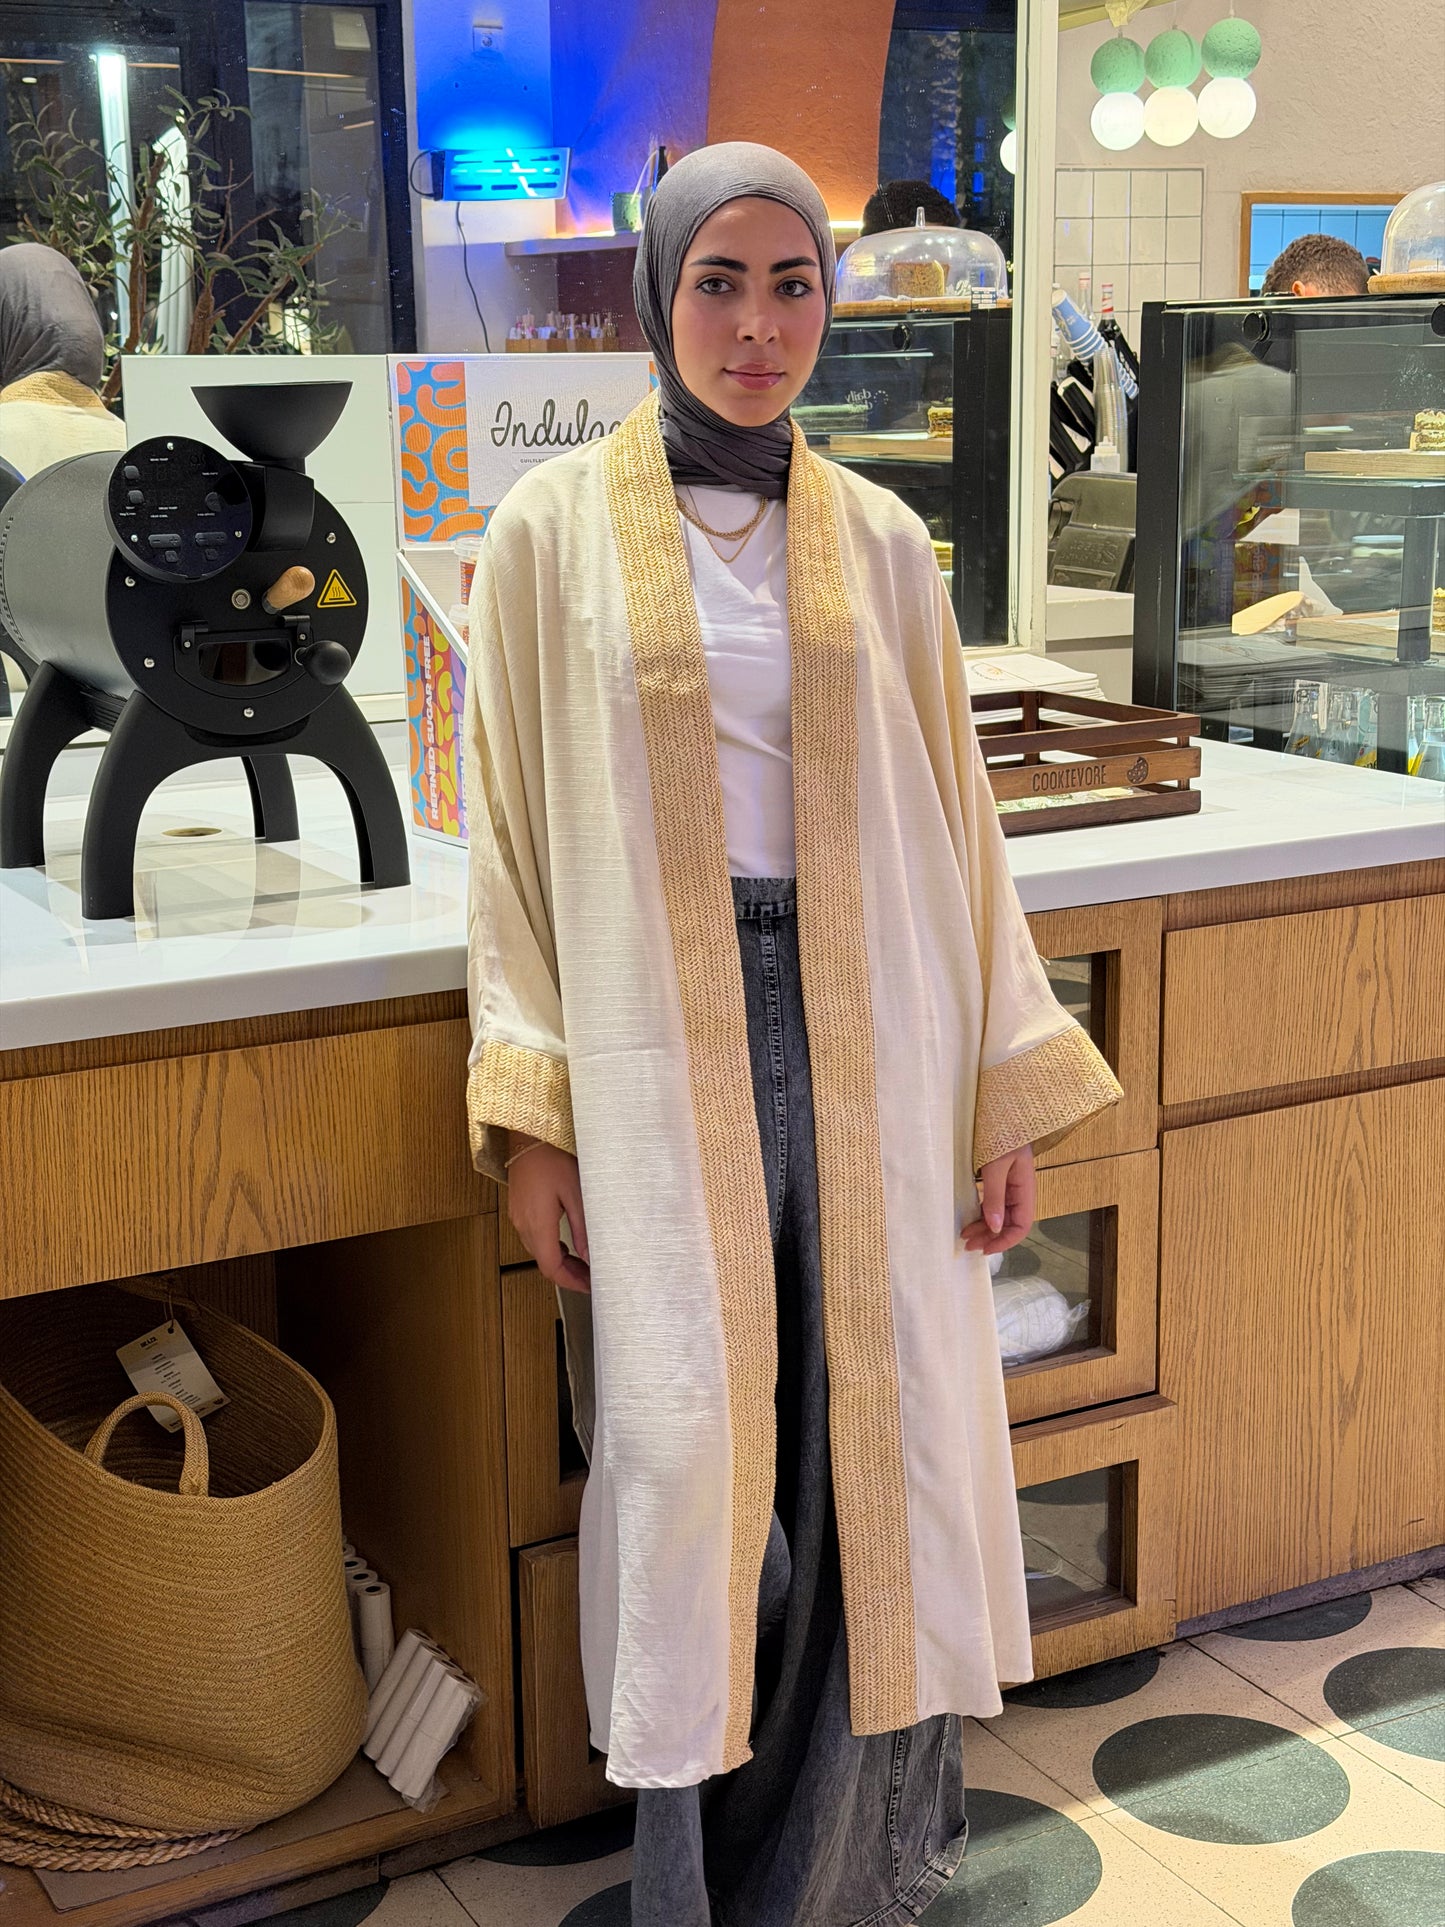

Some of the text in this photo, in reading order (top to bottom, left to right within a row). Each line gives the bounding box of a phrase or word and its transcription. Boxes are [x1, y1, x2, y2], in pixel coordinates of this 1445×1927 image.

[423, 635, 439, 820] REFINED SUGAR FREE
[1032, 765, 1107, 792] COOKIEVORE
